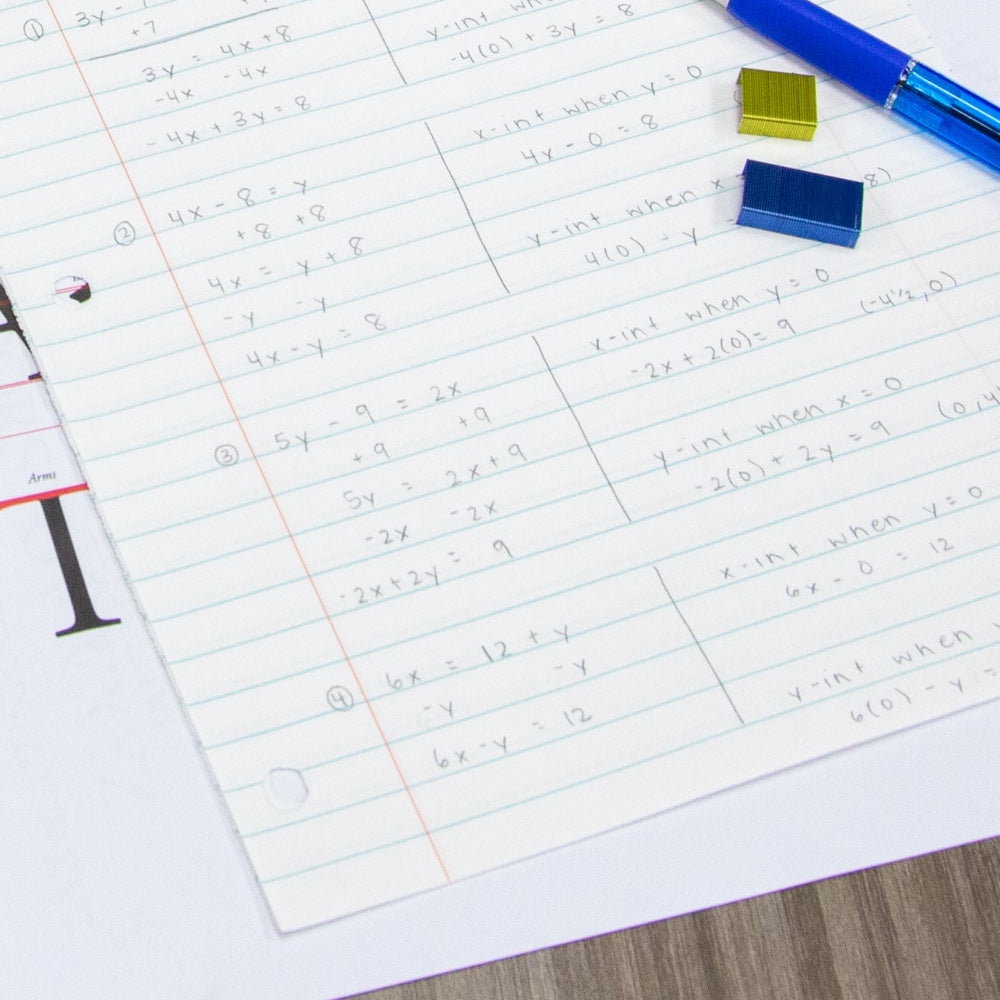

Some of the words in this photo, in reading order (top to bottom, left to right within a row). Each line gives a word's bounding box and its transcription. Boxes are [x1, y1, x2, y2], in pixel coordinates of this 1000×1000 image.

[563, 89, 629, 116] when
[626, 189, 698, 218] when
[686, 293, 750, 321] when
[756, 404, 827, 435] when
[28, 471, 56, 484] Arms
[829, 514, 900, 548] when
[892, 629, 972, 664] when
